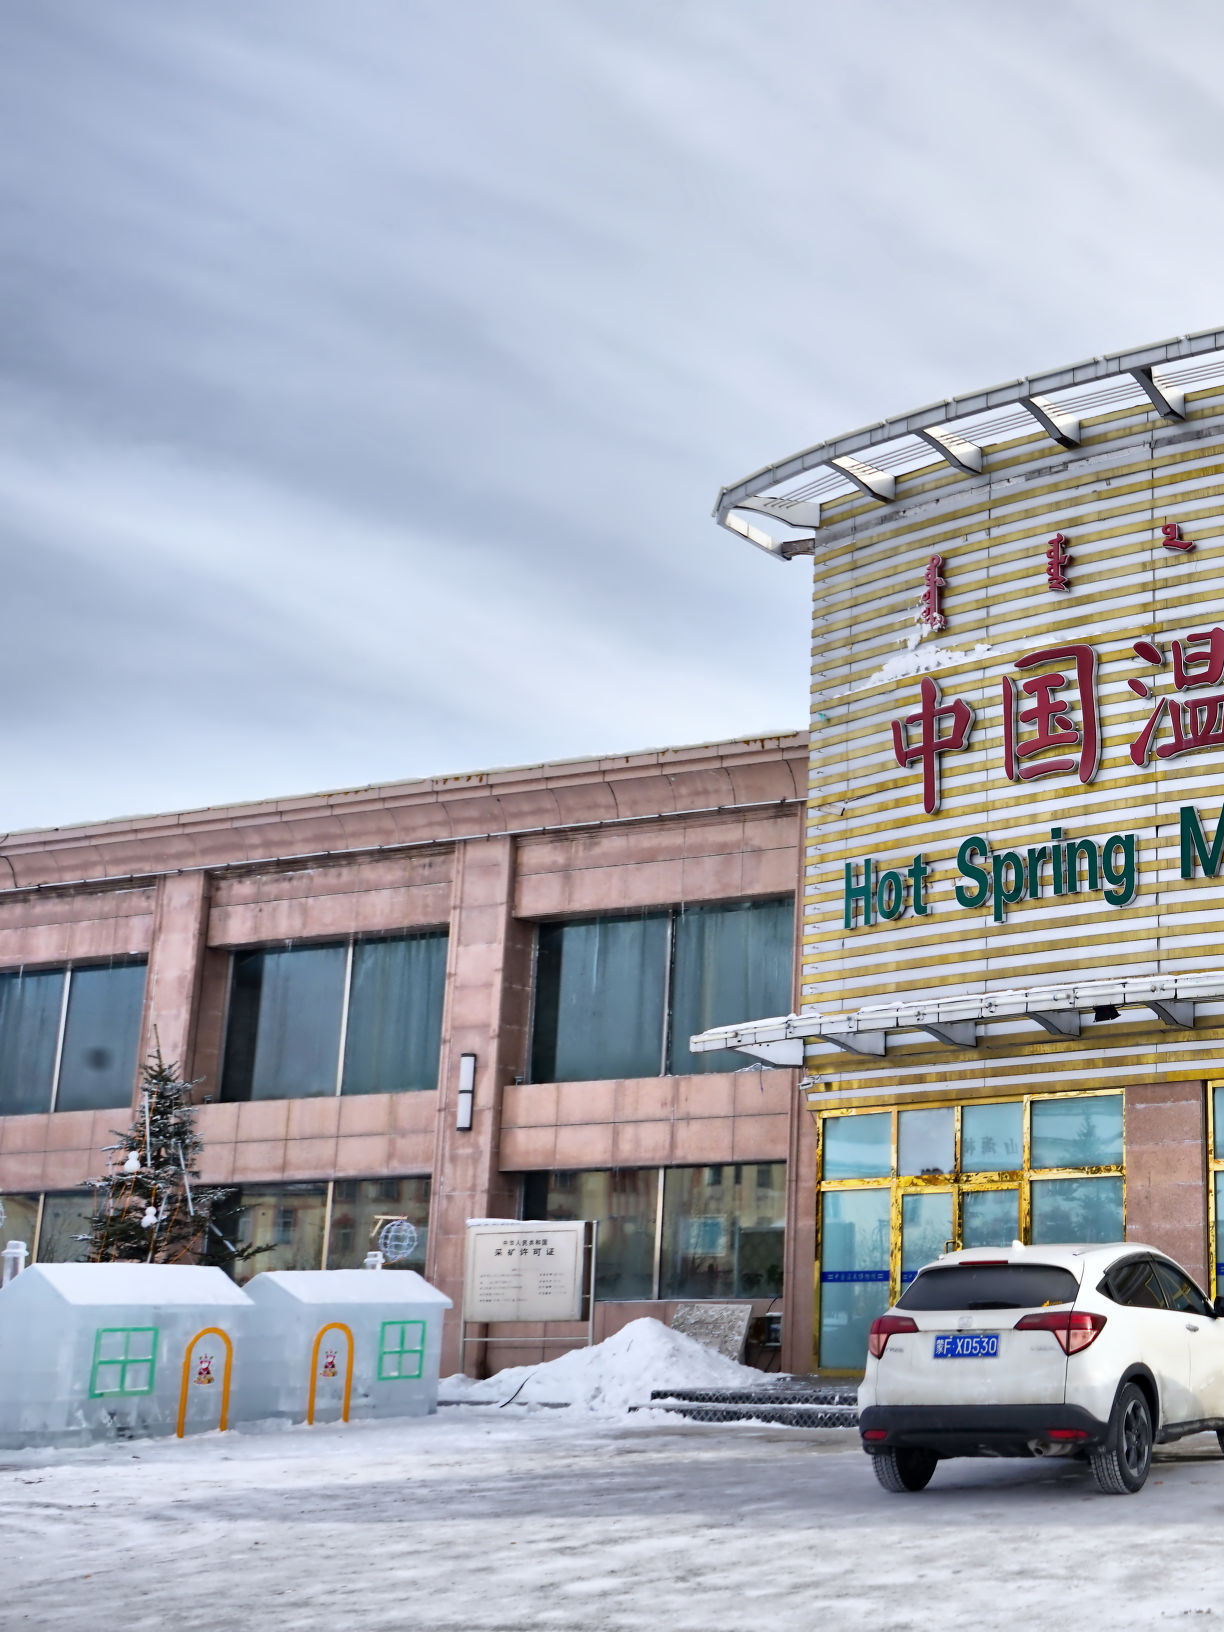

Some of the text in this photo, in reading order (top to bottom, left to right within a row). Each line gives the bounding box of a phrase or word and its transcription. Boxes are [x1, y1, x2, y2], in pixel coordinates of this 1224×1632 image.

[844, 853, 932, 929] Hot
[955, 826, 1138, 922] Spring
[494, 1247, 555, 1256] 采矿许可证
